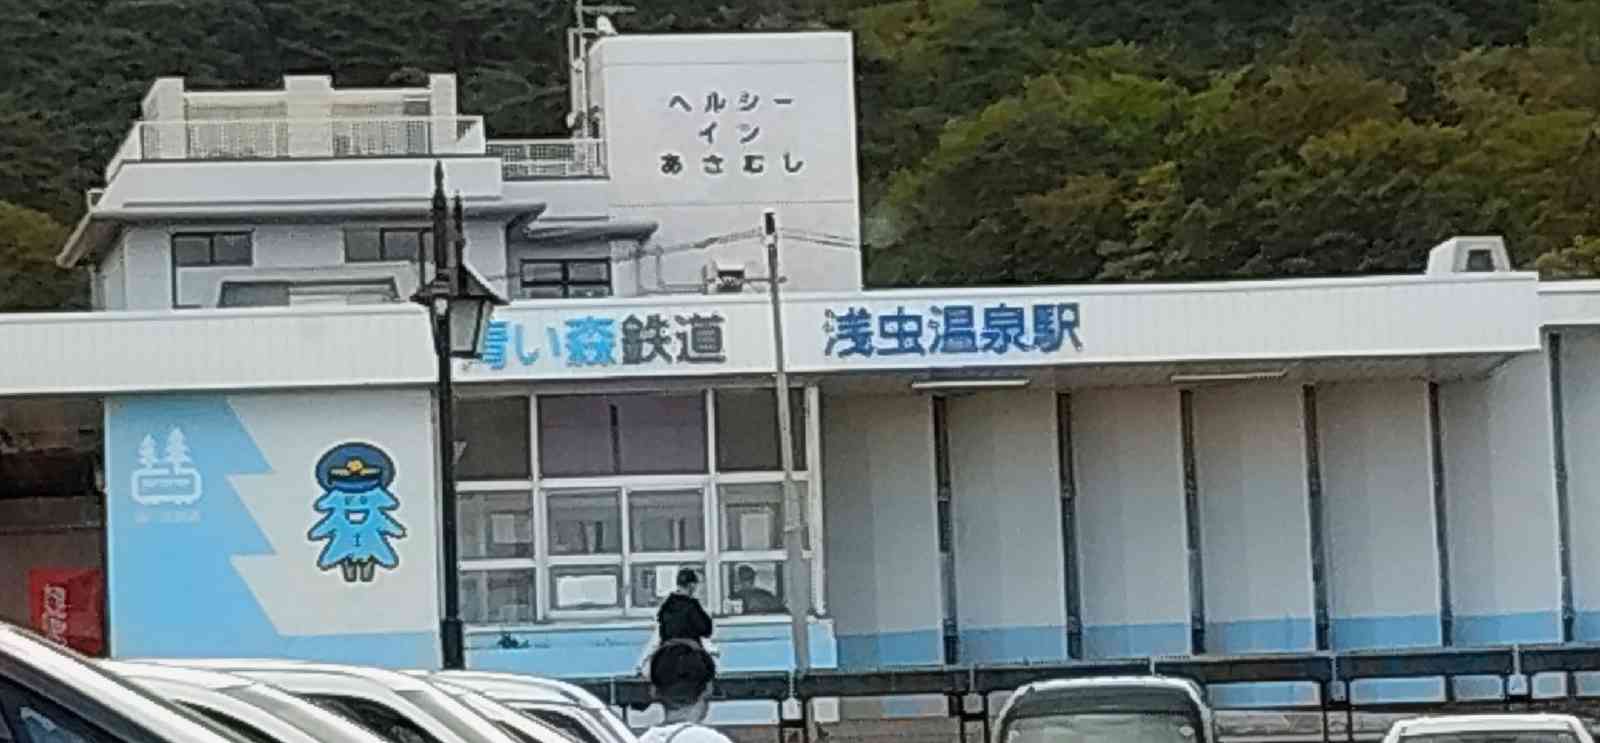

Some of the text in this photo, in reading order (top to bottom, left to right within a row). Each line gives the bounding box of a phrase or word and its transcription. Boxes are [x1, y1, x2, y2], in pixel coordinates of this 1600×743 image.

[669, 91, 793, 112] ヘルシー
[699, 122, 760, 143] イン
[660, 152, 804, 174] あさむし
[823, 303, 1084, 357] 浅虫温泉駅
